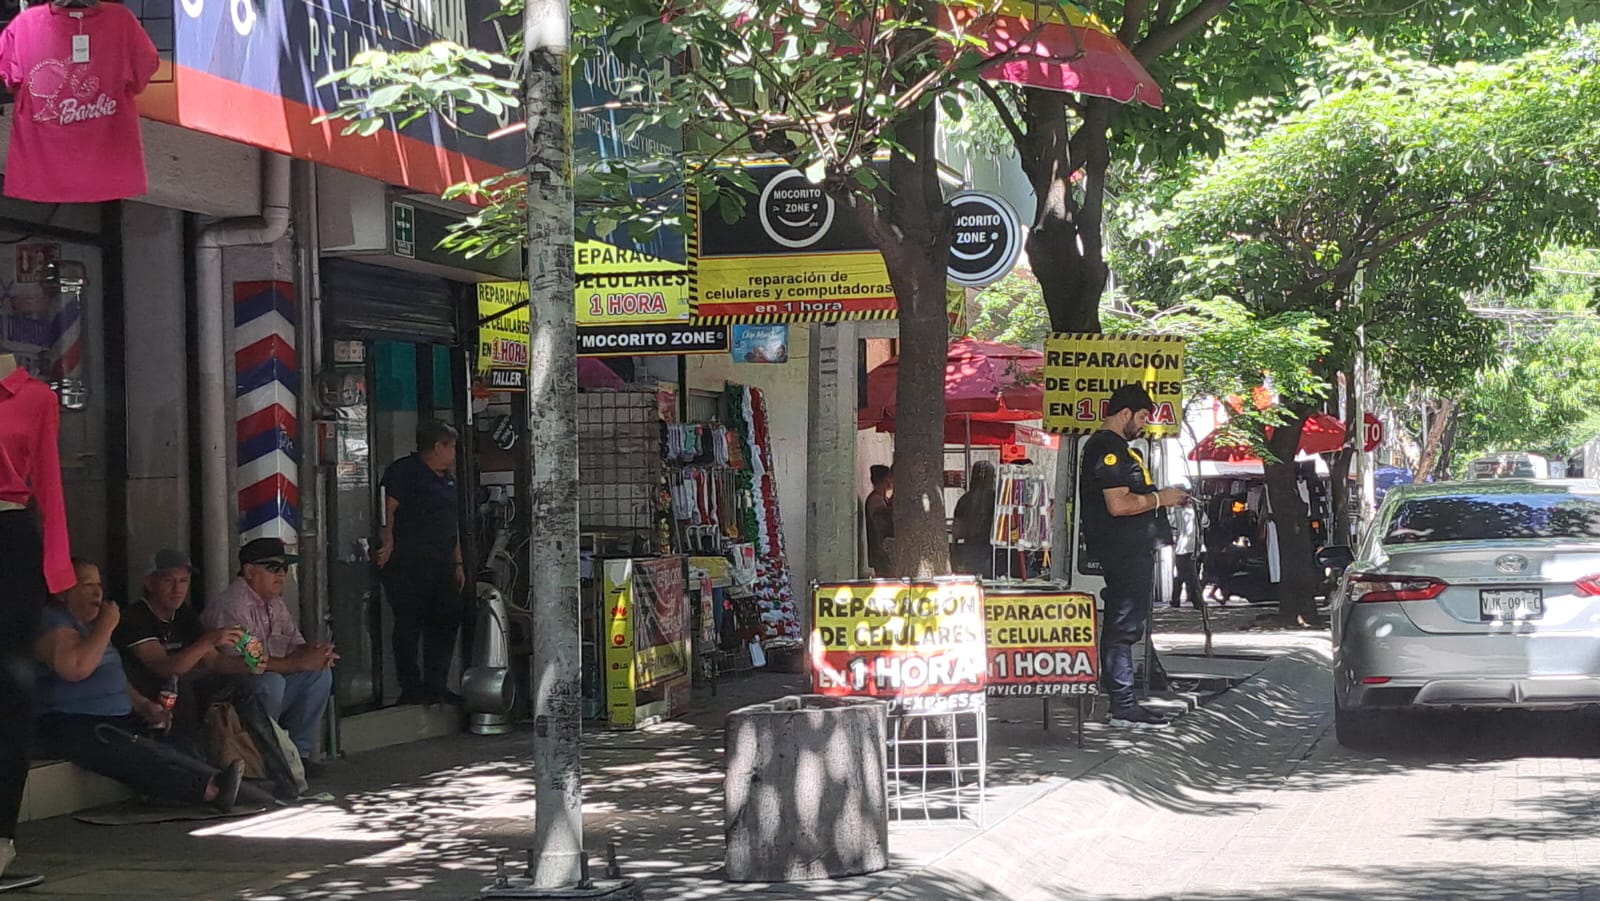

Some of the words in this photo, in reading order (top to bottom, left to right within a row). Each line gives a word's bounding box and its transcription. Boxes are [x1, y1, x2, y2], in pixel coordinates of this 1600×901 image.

[60, 93, 117, 125] Barbie
[774, 188, 821, 200] MOCORITO
[785, 203, 810, 213] ZONE
[955, 214, 1001, 227] CORITO
[957, 231, 987, 244] ZONE
[749, 272, 826, 288] reparación
[830, 271, 848, 282] de
[705, 287, 770, 300] celulares
[775, 287, 783, 298] y
[788, 283, 893, 298] computadoras
[590, 293, 603, 315] 1
[608, 291, 667, 315] HORA
[755, 303, 777, 313] en
[785, 302, 792, 312] 1
[800, 301, 842, 312] hora
[582, 332, 667, 348] MOCORITO
[482, 342, 492, 358] EN
[501, 341, 528, 364] HORA
[1047, 349, 1179, 370] REPARACIÓN
[492, 371, 521, 386] TALLER
[1045, 377, 1070, 391] DE
[1050, 403, 1073, 416] EN
[1076, 397, 1096, 421] 1
[1363, 423, 1380, 441] TO
[819, 591, 976, 618] REPARACIÓN
[984, 598, 1092, 620] EPARACIÓN
[1482, 596, 1541, 611] VJK-091-C
[820, 626, 847, 646] DE
[854, 625, 977, 647] CELULARES
[997, 627, 1093, 644] CELULARES
[818, 670, 847, 688] EN
[848, 656, 868, 691] 1
[874, 654, 978, 688] HORA
[995, 653, 1007, 677] 1
[1015, 651, 1094, 677] HORA
[986, 684, 1031, 696] RVICIO
[1036, 683, 1097, 695] EXPRESS
